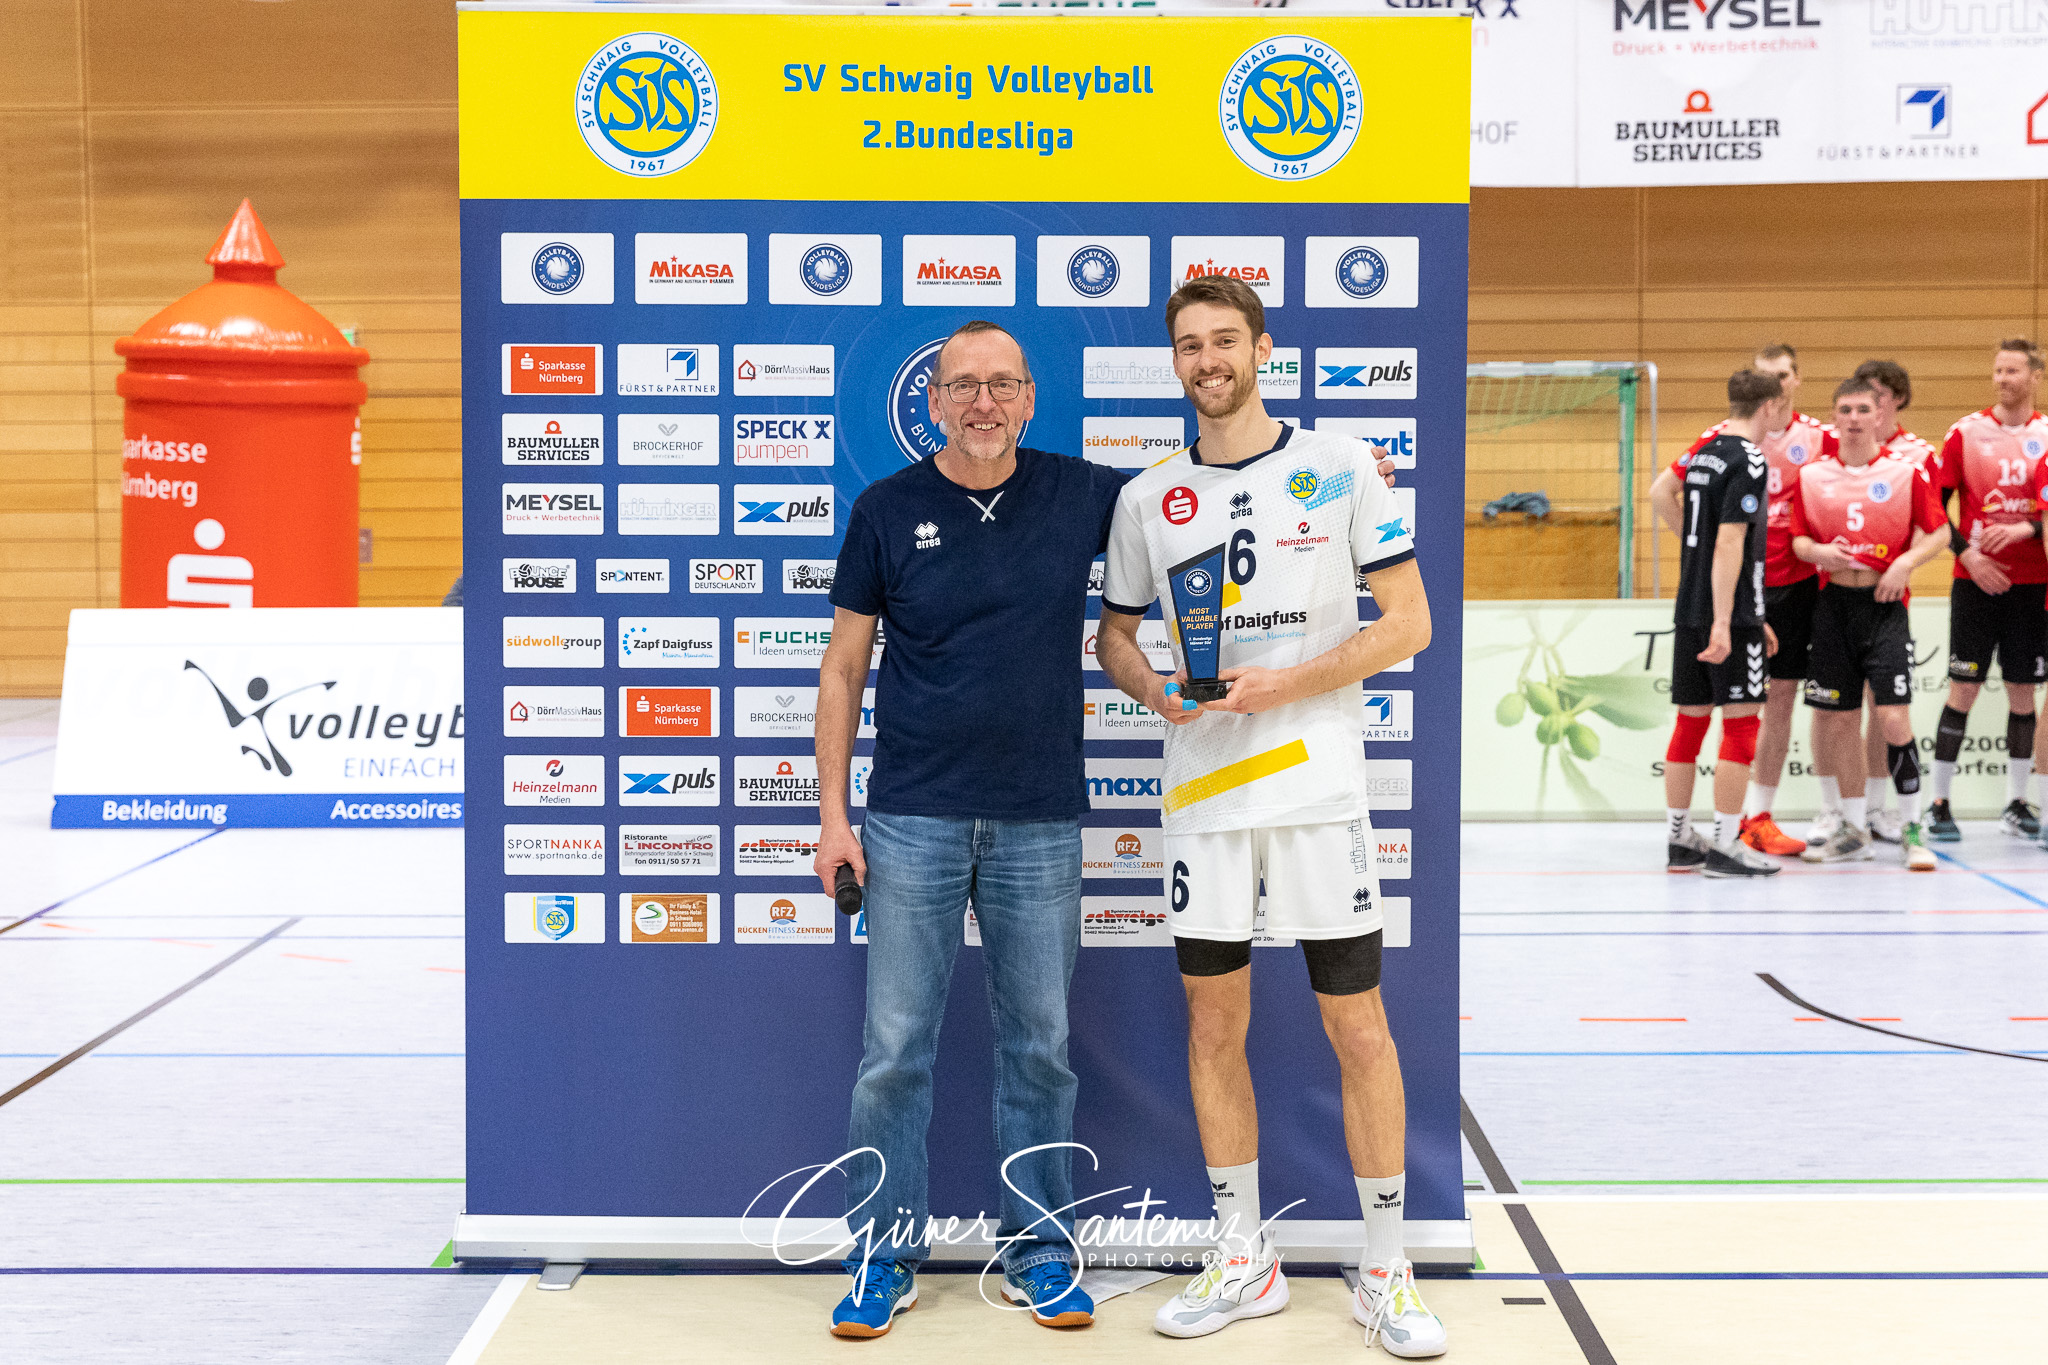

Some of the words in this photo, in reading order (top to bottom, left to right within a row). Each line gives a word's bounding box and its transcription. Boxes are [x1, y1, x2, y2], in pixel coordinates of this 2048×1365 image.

[1614, 0, 1821, 31] MEYSEL
[1612, 40, 1666, 56] Druck
[1691, 37, 1819, 54] Werbetechnik
[581, 41, 632, 102] SCHWAIG
[1225, 44, 1277, 106] SCHWAIG
[658, 39, 713, 129] VOLLEYBALL
[784, 64, 827, 92] SV
[840, 64, 973, 100] Schwaig
[987, 65, 1154, 101] Volleyball
[1303, 42, 1357, 132] VOLLEYBALL
[582, 110, 595, 129] SV
[1227, 113, 1239, 132] SV
[863, 120, 1073, 156] 2.Bundesliga
[1633, 141, 1762, 163] SERVICES
[629, 159, 667, 172] 1967
[1272, 162, 1309, 175] 1967
[538, 248, 577, 266] VOLLEYBALL
[807, 249, 845, 267] VOLLEYBALL
[1073, 253, 1113, 269] VOLLEYBALL
[1342, 254, 1381, 270] VOLLEYBALL
[539, 272, 578, 290] BUNDESLIGA
[808, 274, 845, 291] BUNDESLIGA
[1075, 276, 1113, 293] BUNDESLIGA
[1343, 277, 1381, 293] BUNDESLIGA
[538, 360, 586, 373] Sparkasse
[764, 364, 830, 375] DörrMassivHaus
[539, 373, 583, 385] Nürnberg
[737, 420, 808, 439] SPECK
[633, 441, 704, 451] BROCKERHOF
[737, 443, 809, 463] pumpen
[517, 450, 590, 461] SERVICES
[1768, 467, 1783, 494] 8
[1997, 458, 2028, 487] 13
[506, 494, 602, 510] MEYSEL
[506, 514, 531, 522] Druck
[541, 513, 601, 522] Werbetechnik
[1230, 506, 1253, 520] errea
[1687, 490, 1700, 547] 1
[1846, 502, 1865, 532] 5
[916, 537, 941, 549] errea
[1276, 535, 1330, 548] Heinzelmann
[1228, 528, 1257, 586] 6
[695, 564, 756, 581] SPORT
[788, 565, 836, 581] BOUNC
[514, 577, 564, 589] HOUSE
[1181, 614, 1218, 623] VALUABLE
[1188, 607, 1210, 615] MOST
[1186, 622, 1214, 630] PLAYER
[1234, 611, 1307, 630] Daigfuss
[633, 639, 660, 650] Zapf
[662, 639, 713, 650] Daigfuss
[759, 631, 832, 644] FUCHS
[759, 647, 785, 656] Ideen
[1893, 674, 1907, 697] 5
[537, 706, 602, 717] DörrMassivHaus
[654, 703, 701, 714] Sparkasse
[655, 715, 699, 727] Nürnberg
[750, 713, 817, 722] BROCKERHO
[1105, 718, 1131, 727] Ideen
[344, 757, 457, 779] EINFACH
[513, 781, 597, 793] Heinzelmann
[539, 795, 571, 805] Medien
[749, 791, 821, 801] SERVICES
[102, 800, 228, 823] Bekleidung
[331, 799, 462, 820] Accessoires
[507, 839, 603, 849] SPORTNANKA
[1117, 841, 1139, 852] RFZ
[507, 852, 603, 862] www.sportnanka.de
[1172, 860, 1190, 913] 6
[772, 907, 795, 917] RFZ
[1353, 901, 1372, 913] errea
[1373, 1201, 1401, 1209] erima
